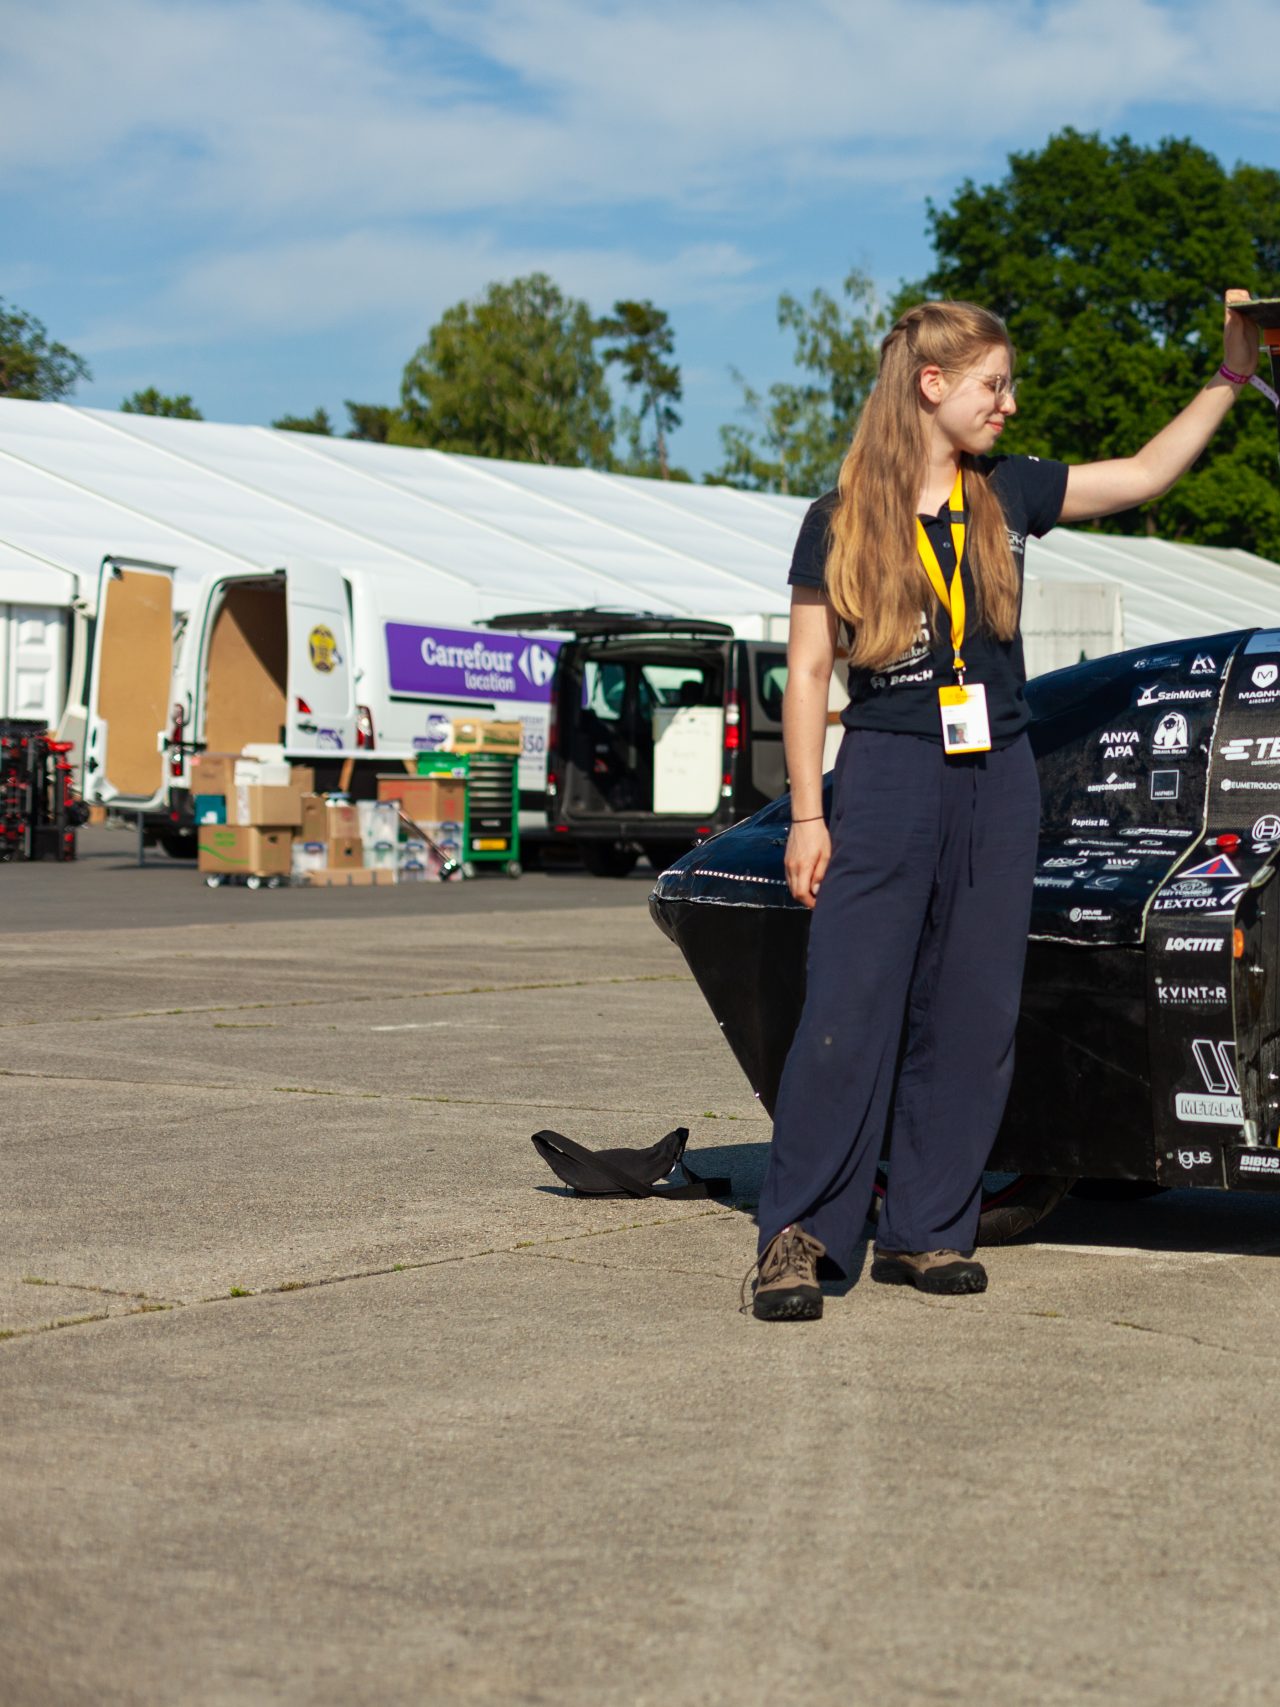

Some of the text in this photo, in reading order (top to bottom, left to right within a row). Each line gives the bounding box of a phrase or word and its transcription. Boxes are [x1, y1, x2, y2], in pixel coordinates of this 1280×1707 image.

[421, 637, 514, 672] Carrefour
[464, 670, 516, 692] location
[890, 669, 933, 686] BOSCH
[1099, 731, 1140, 744] ANYA
[1104, 745, 1133, 758] APA
[1071, 818, 1110, 827] Paptisz Bt.
[1153, 897, 1218, 910] LEXTOR
[1165, 937, 1224, 952] LOCTITE
[1178, 1148, 1212, 1169] igus
[1240, 1154, 1279, 1168] BIBUS
